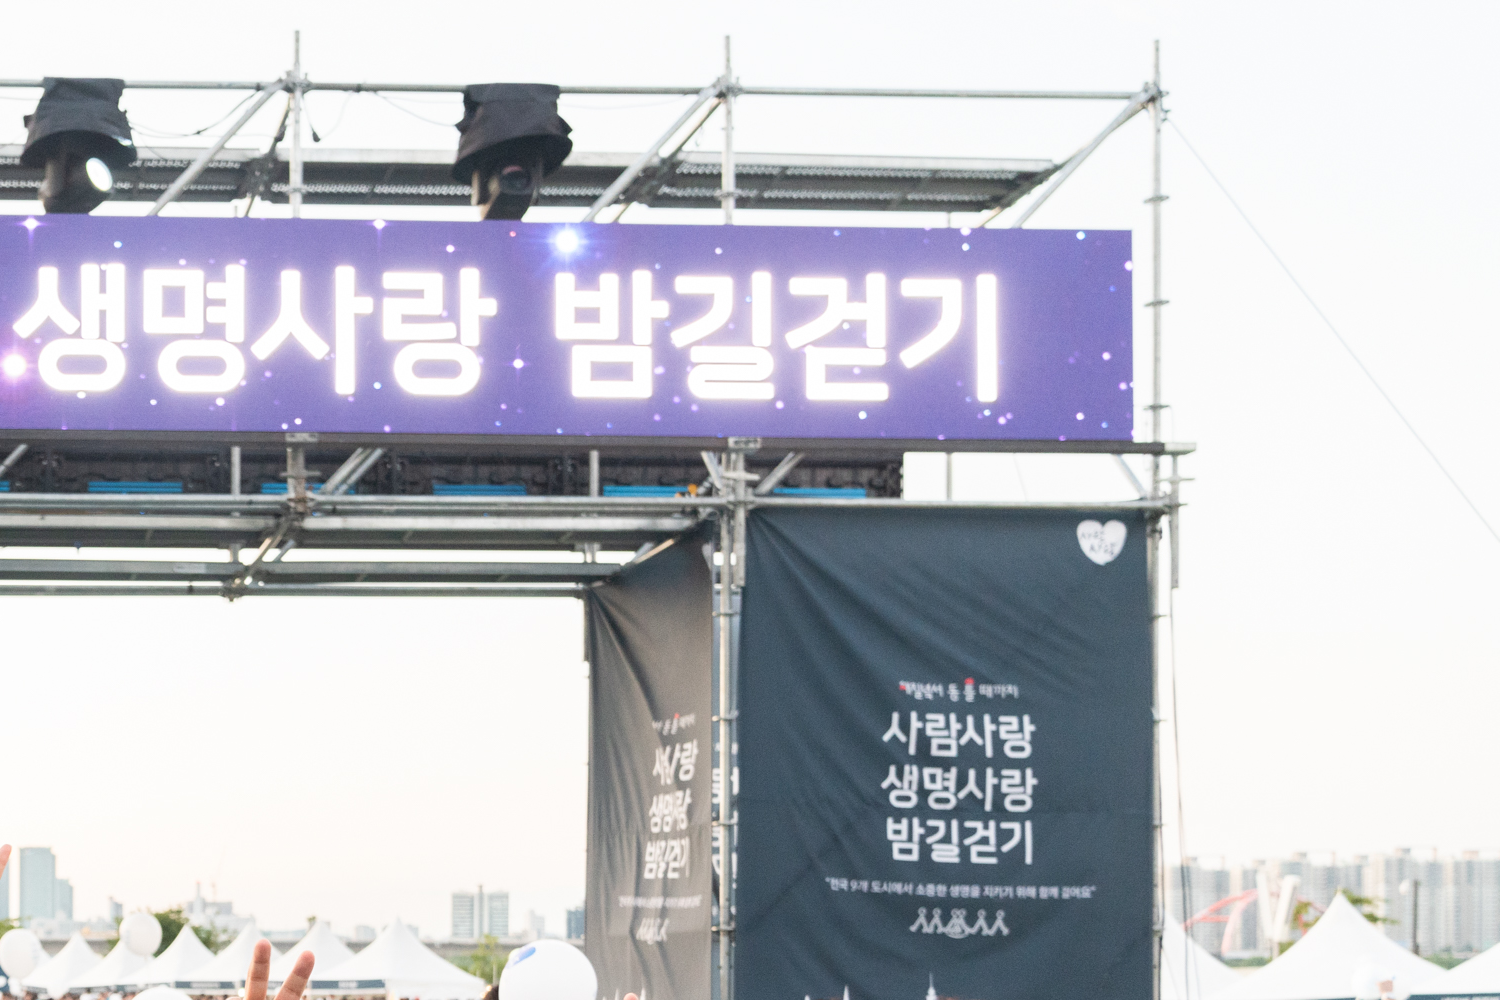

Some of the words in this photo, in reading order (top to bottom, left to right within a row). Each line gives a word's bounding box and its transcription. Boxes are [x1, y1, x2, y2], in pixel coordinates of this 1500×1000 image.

[12, 261, 498, 397] 생명사랑
[554, 269, 998, 402] 밤길걷기
[881, 710, 1037, 759] 사람사랑
[880, 763, 1039, 813] 생명사랑
[886, 816, 1034, 865] 밤길걷기
